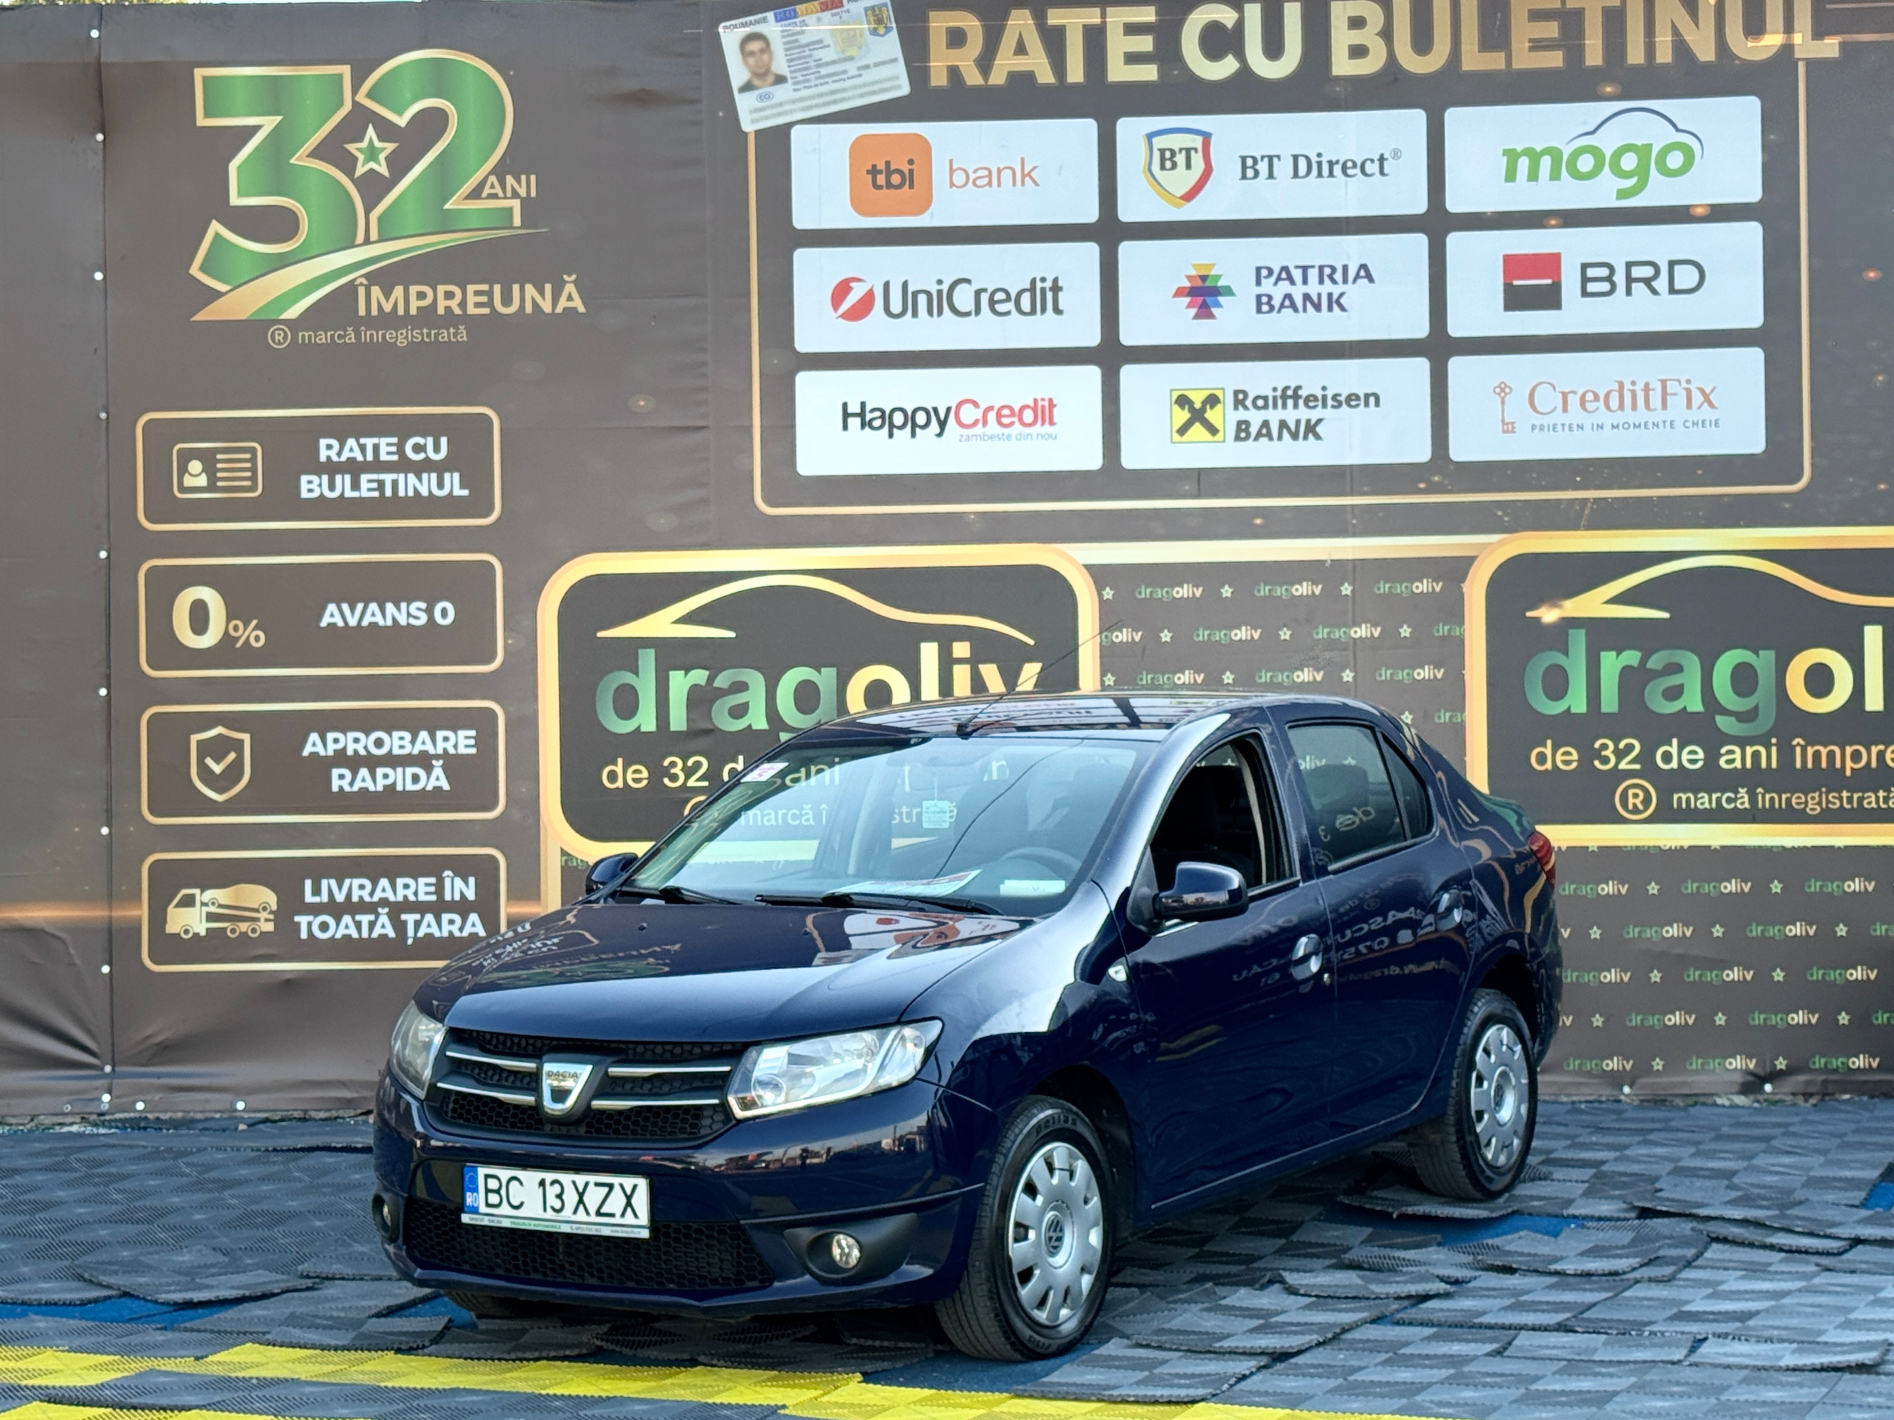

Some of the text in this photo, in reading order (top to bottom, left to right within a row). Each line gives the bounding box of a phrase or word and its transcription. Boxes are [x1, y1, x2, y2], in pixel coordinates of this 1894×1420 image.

[928, 0, 1841, 88] RATE CU BULETINUL
[1158, 147, 1198, 173] BT
[1239, 155, 1281, 181] BT
[1502, 141, 1696, 201] mogo
[481, 174, 537, 198] ANI
[866, 157, 1040, 191] tbi bank
[1255, 262, 1376, 287] PATRIA
[1580, 259, 1707, 299] BRD
[357, 275, 586, 316] ÎMPREUNĂ
[882, 276, 1064, 320] UniCredit
[1255, 290, 1349, 315] BANK
[298, 326, 356, 344] marcă
[360, 325, 467, 347] înregistrată
[1233, 385, 1381, 412] Raiffeisen
[1527, 378, 1719, 416] CreditFix
[841, 397, 1058, 440] HappyCredit
[1233, 418, 1325, 443] BANK
[1530, 418, 1721, 433] PRIETEN IN MOMENTE CHEIE
[319, 436, 448, 463] RATE CU
[1015, 431, 1034, 442] din
[1037, 432, 1058, 442] nou
[300, 472, 469, 500] BULETINUL
[1136, 579, 1443, 601] dragoliv dragoliv dragoliv
[320, 602, 427, 628] AVANS
[1193, 626, 1261, 644] dragoliv
[1312, 623, 1382, 642] dragoliv
[1137, 665, 1445, 688] dragoliv dragoliv dragoliv
[302, 729, 477, 757] APROBARE
[1530, 739, 1578, 771] de
[1593, 738, 1641, 770] 32
[1656, 738, 1704, 770] de
[1719, 738, 1777, 770] ani
[331, 761, 451, 793] RAPIDĂ
[602, 758, 648, 789] de
[663, 756, 709, 787] 32
[1673, 788, 1749, 809] marcă
[304, 869, 476, 903] LIVRARE ÎN
[1558, 877, 1875, 898] dragoliv dragoliv dragoliv
[294, 907, 487, 945] TOATĂ ȚARA
[1622, 921, 1817, 941] dragoliv dragoliv
[1562, 965, 1878, 986] dragoliv dragoliv dragoliv
[1625, 1009, 1819, 1029] dragoliv dragoliv
[547, 1070, 578, 1079] DACIA
[1563, 1053, 1880, 1074] dragoliv dragoliv dragoliv
[466, 1192, 478, 1207] RO
[483, 1174, 525, 1211] BC
